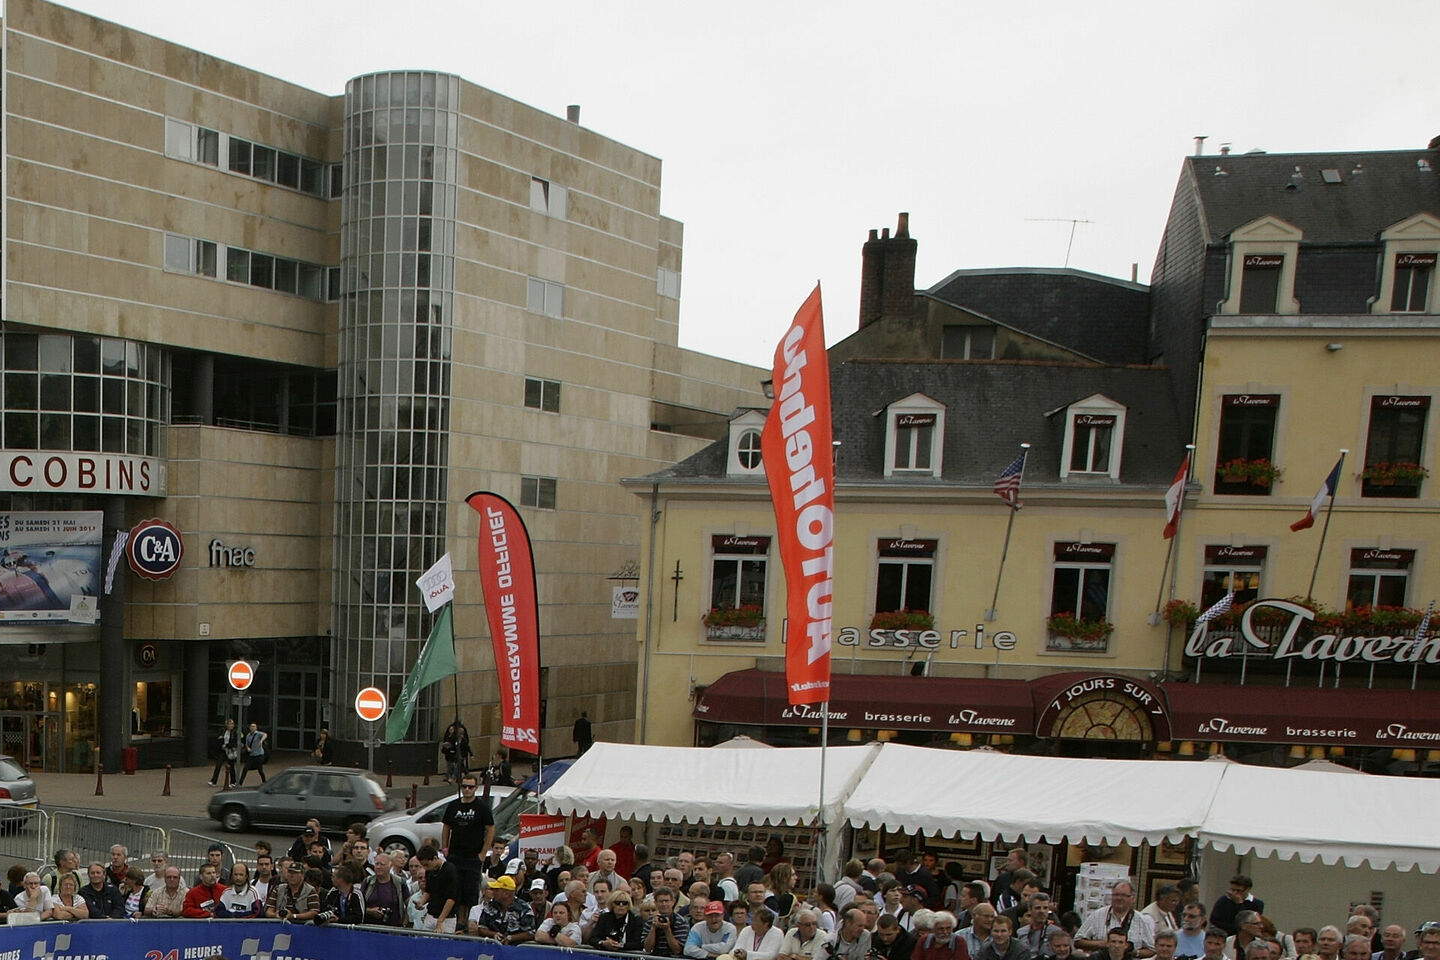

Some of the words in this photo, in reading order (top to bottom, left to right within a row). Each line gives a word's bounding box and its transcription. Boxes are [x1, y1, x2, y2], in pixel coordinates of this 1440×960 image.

[141, 536, 175, 562] C&A
[210, 539, 256, 567] fnac
[1184, 619, 1234, 658] la
[1051, 700, 1061, 711] 7
[1066, 678, 1115, 701] JOURS
[1123, 682, 1152, 704] SUR
[782, 709, 793, 719] la
[864, 711, 932, 723] brasserie
[948, 714, 960, 724] la
[959, 709, 1015, 726] Taverne
[1198, 722, 1210, 732] la
[1209, 717, 1267, 735] Taverne
[1286, 726, 1357, 739] brasserie
[1376, 728, 1387, 738] la
[520, 825, 531, 834] 24
[184, 944, 222, 959] HEURES
